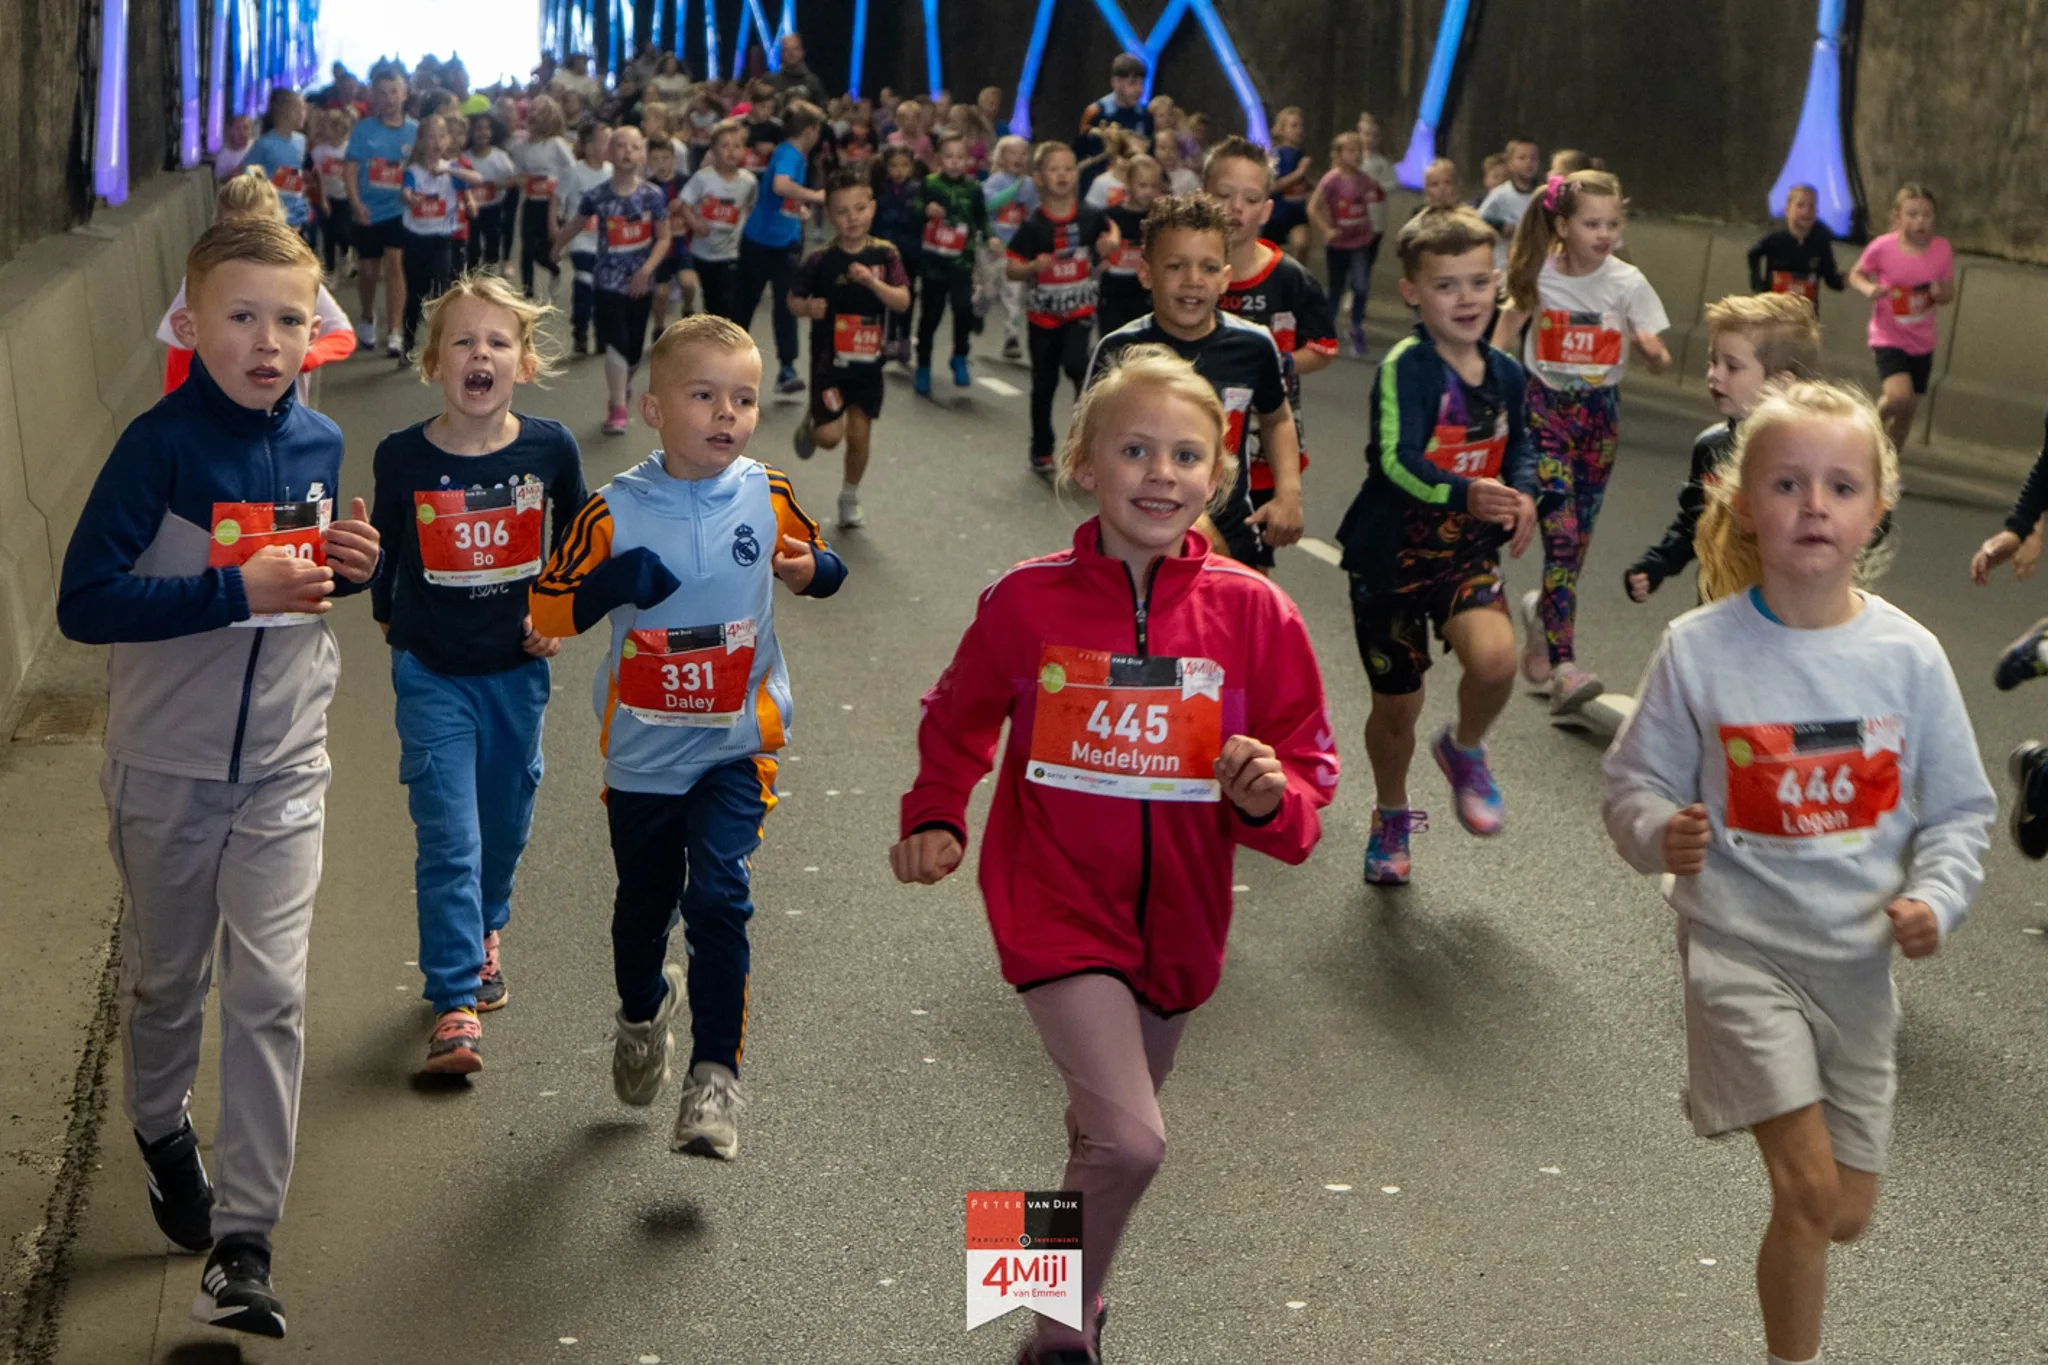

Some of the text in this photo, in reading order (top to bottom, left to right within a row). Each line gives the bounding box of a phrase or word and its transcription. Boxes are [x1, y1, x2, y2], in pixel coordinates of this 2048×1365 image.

[1219, 295, 1266, 310] 2025
[1562, 331, 1594, 351] 471
[454, 519, 510, 549] 306
[472, 551, 495, 566] Bo
[661, 660, 715, 691] 331
[665, 693, 716, 712] Daley
[1086, 699, 1169, 744] 445
[1071, 740, 1180, 775] Medelynn
[1776, 763, 1856, 808] 446
